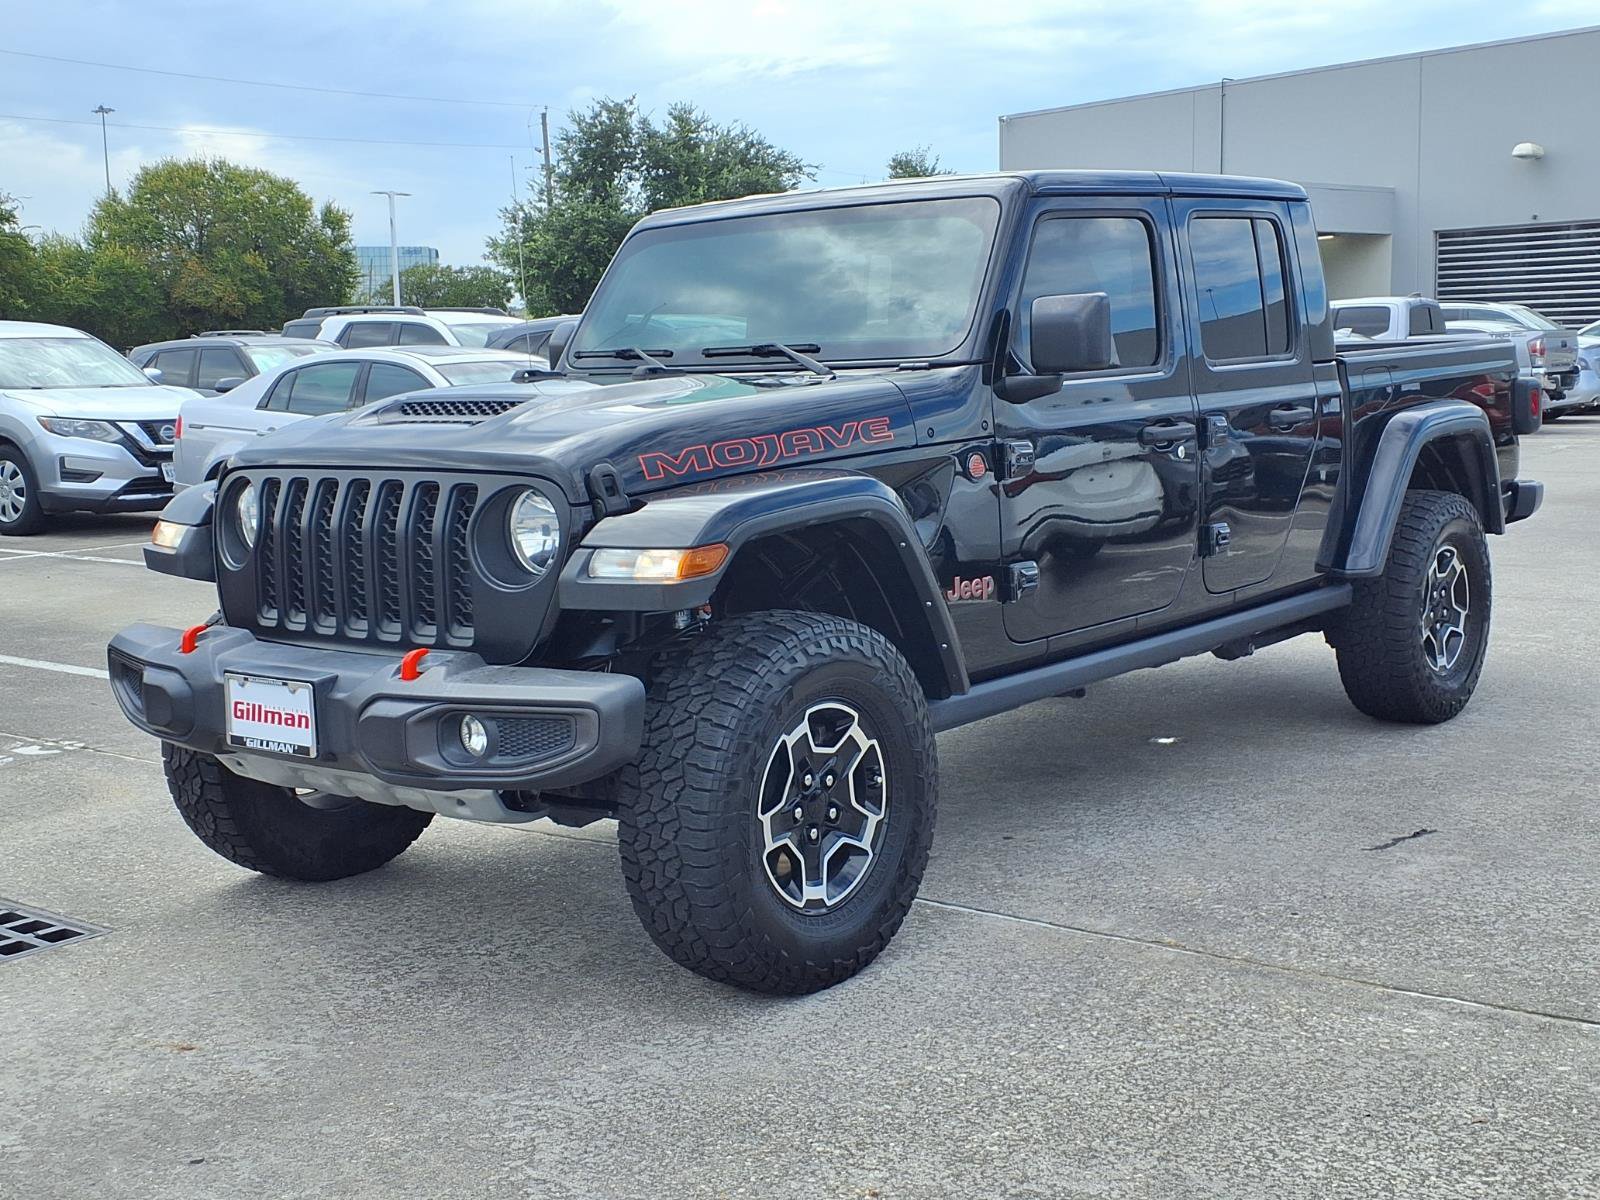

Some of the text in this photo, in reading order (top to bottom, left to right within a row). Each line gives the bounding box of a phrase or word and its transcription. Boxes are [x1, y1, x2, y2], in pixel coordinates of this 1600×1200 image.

[638, 416, 894, 480] MOJAVE
[947, 575, 994, 600] Jeep
[233, 701, 309, 729] Gillman
